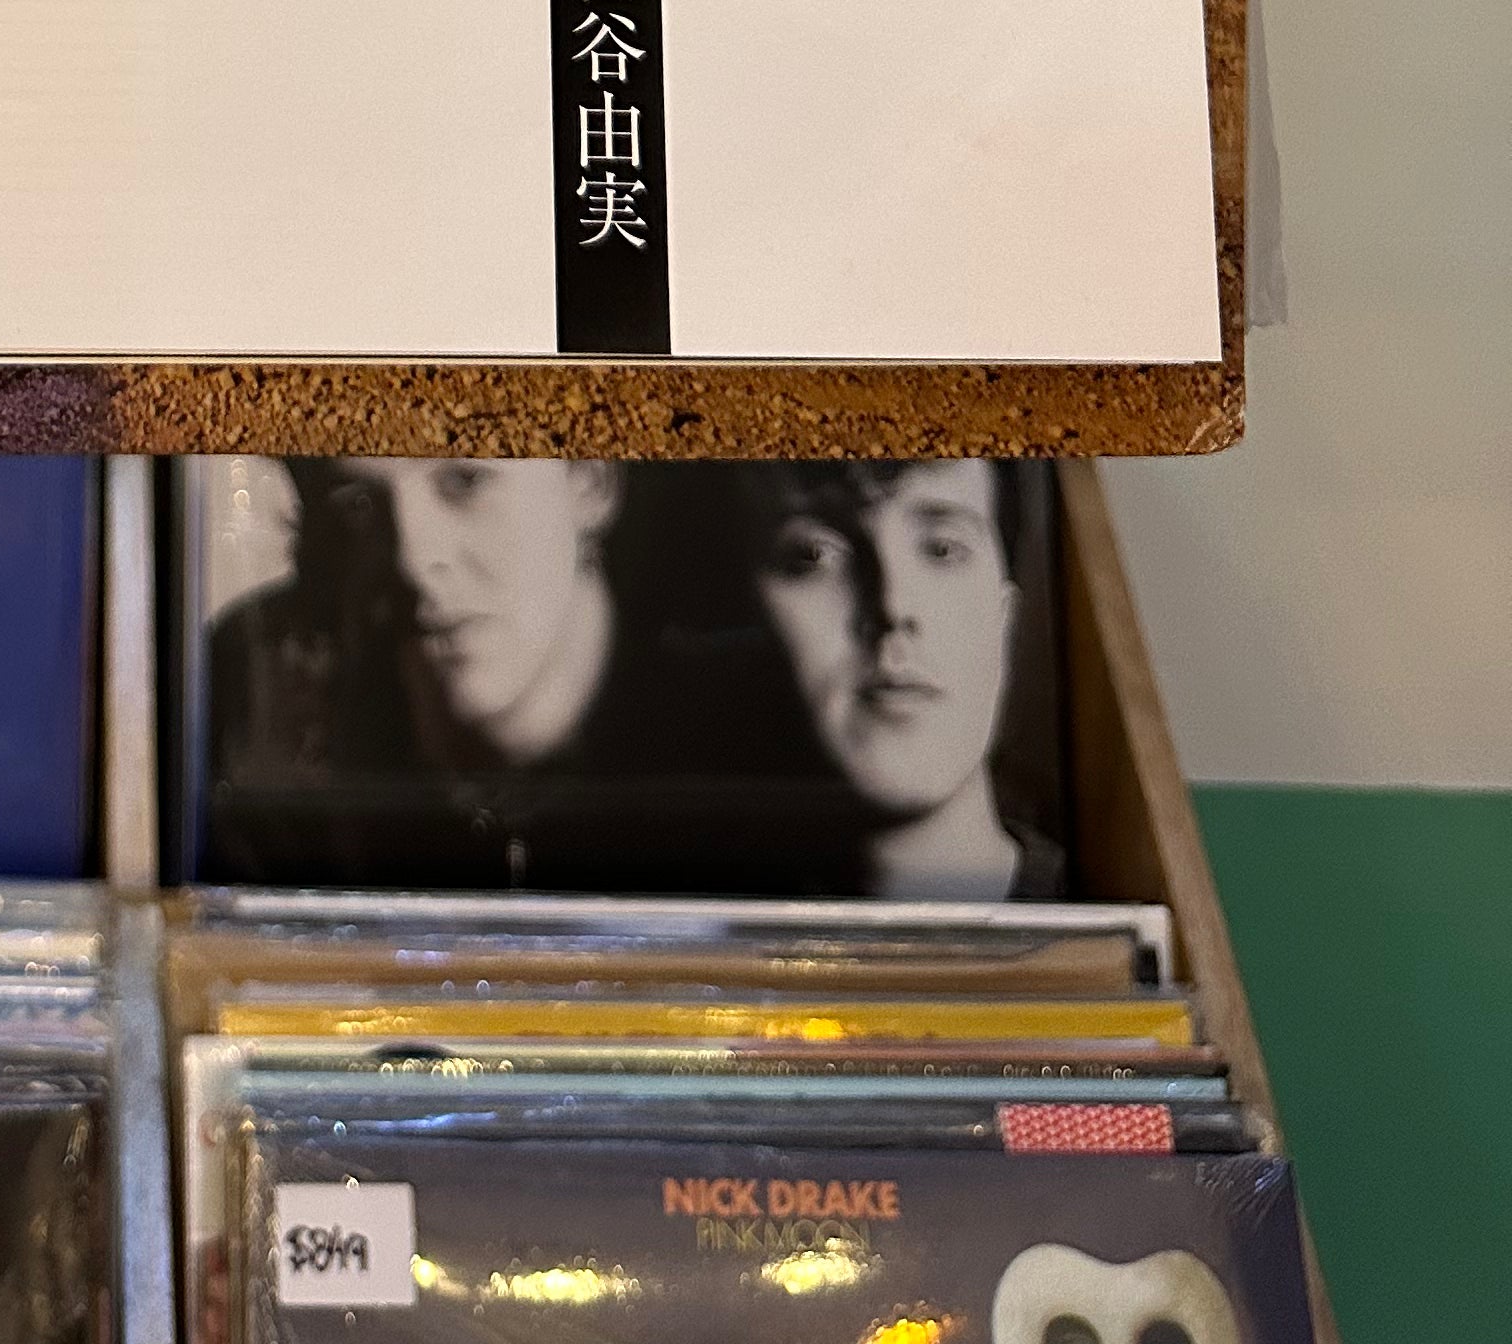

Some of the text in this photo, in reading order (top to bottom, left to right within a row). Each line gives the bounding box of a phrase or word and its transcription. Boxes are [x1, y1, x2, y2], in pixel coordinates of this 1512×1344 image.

[663, 1177, 901, 1220] NICK DRAKE
[285, 1222, 370, 1273] $849
[696, 1216, 871, 1252] PINK MOON
